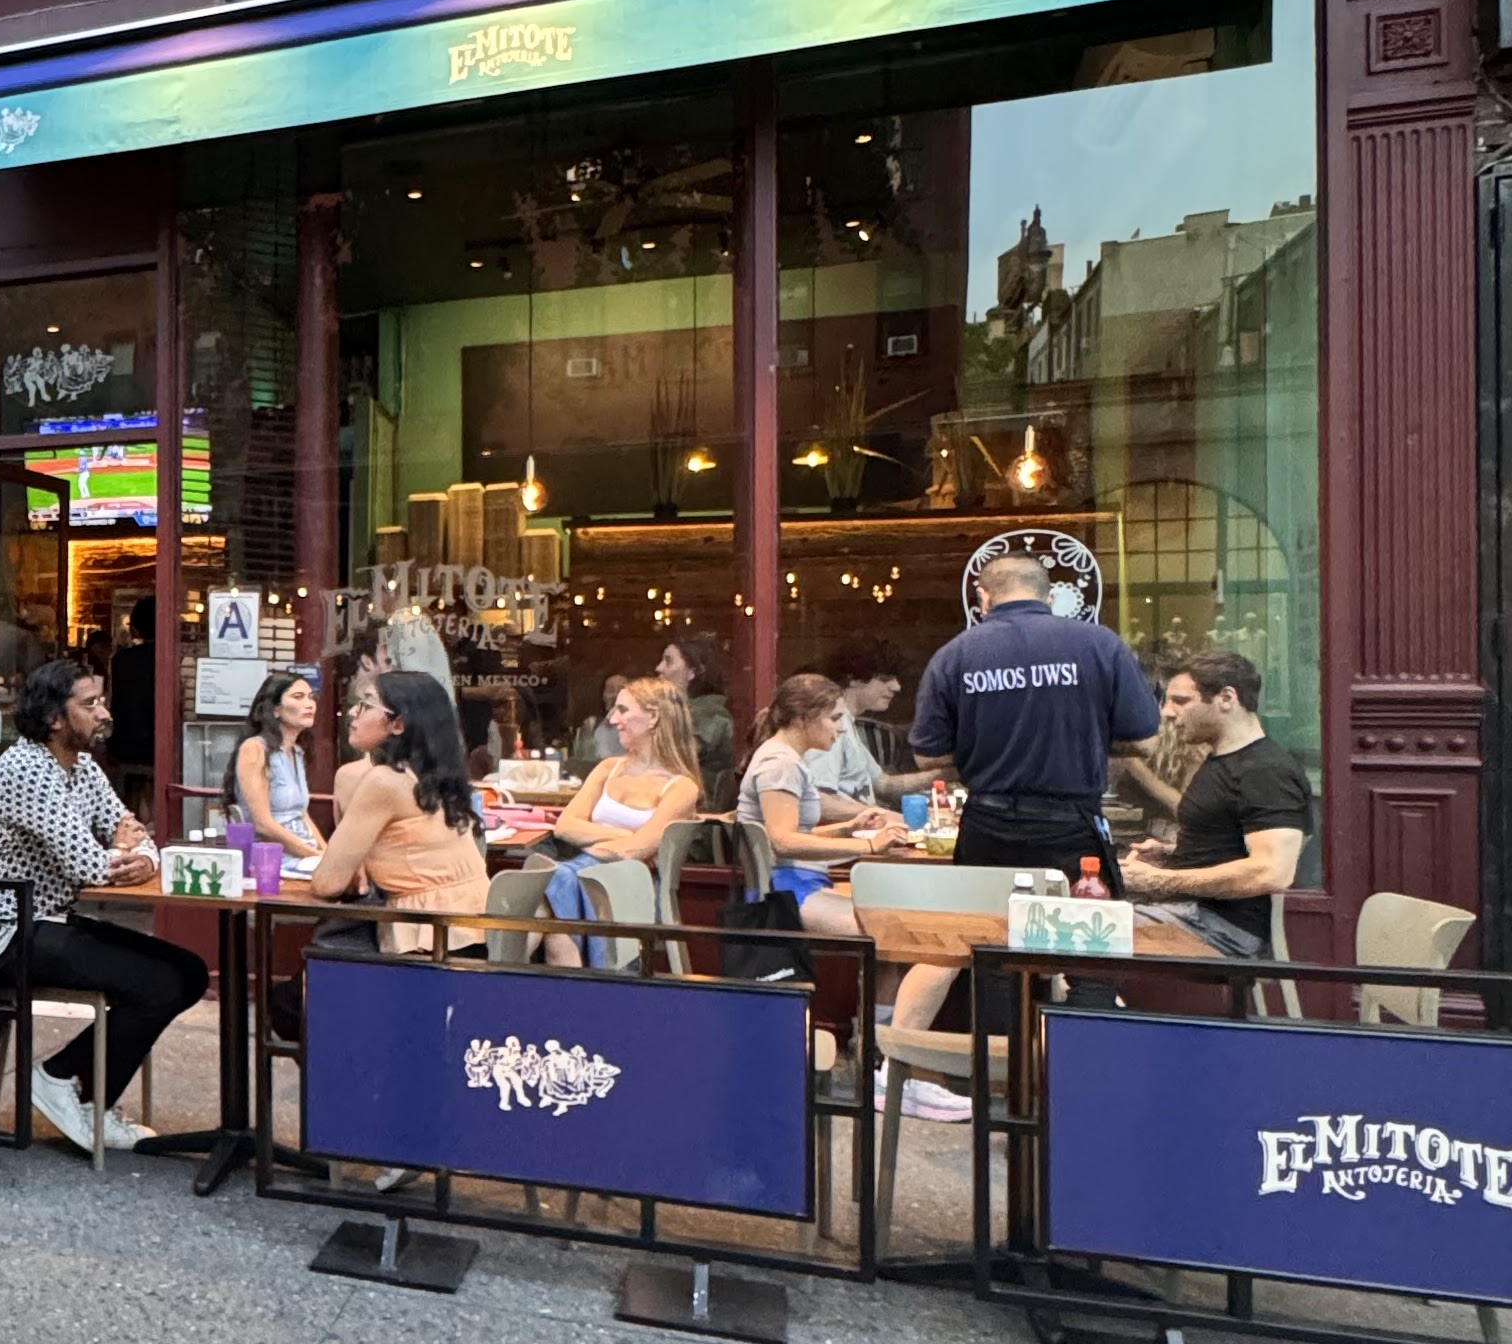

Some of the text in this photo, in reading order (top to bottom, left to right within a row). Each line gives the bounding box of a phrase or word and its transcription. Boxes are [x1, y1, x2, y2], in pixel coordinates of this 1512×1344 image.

[216, 600, 249, 639] A
[477, 674, 541, 688] MEXICO
[962, 662, 1078, 694] SOMOS UWS!
[1321, 1164, 1464, 1206] ANTOJERIA
